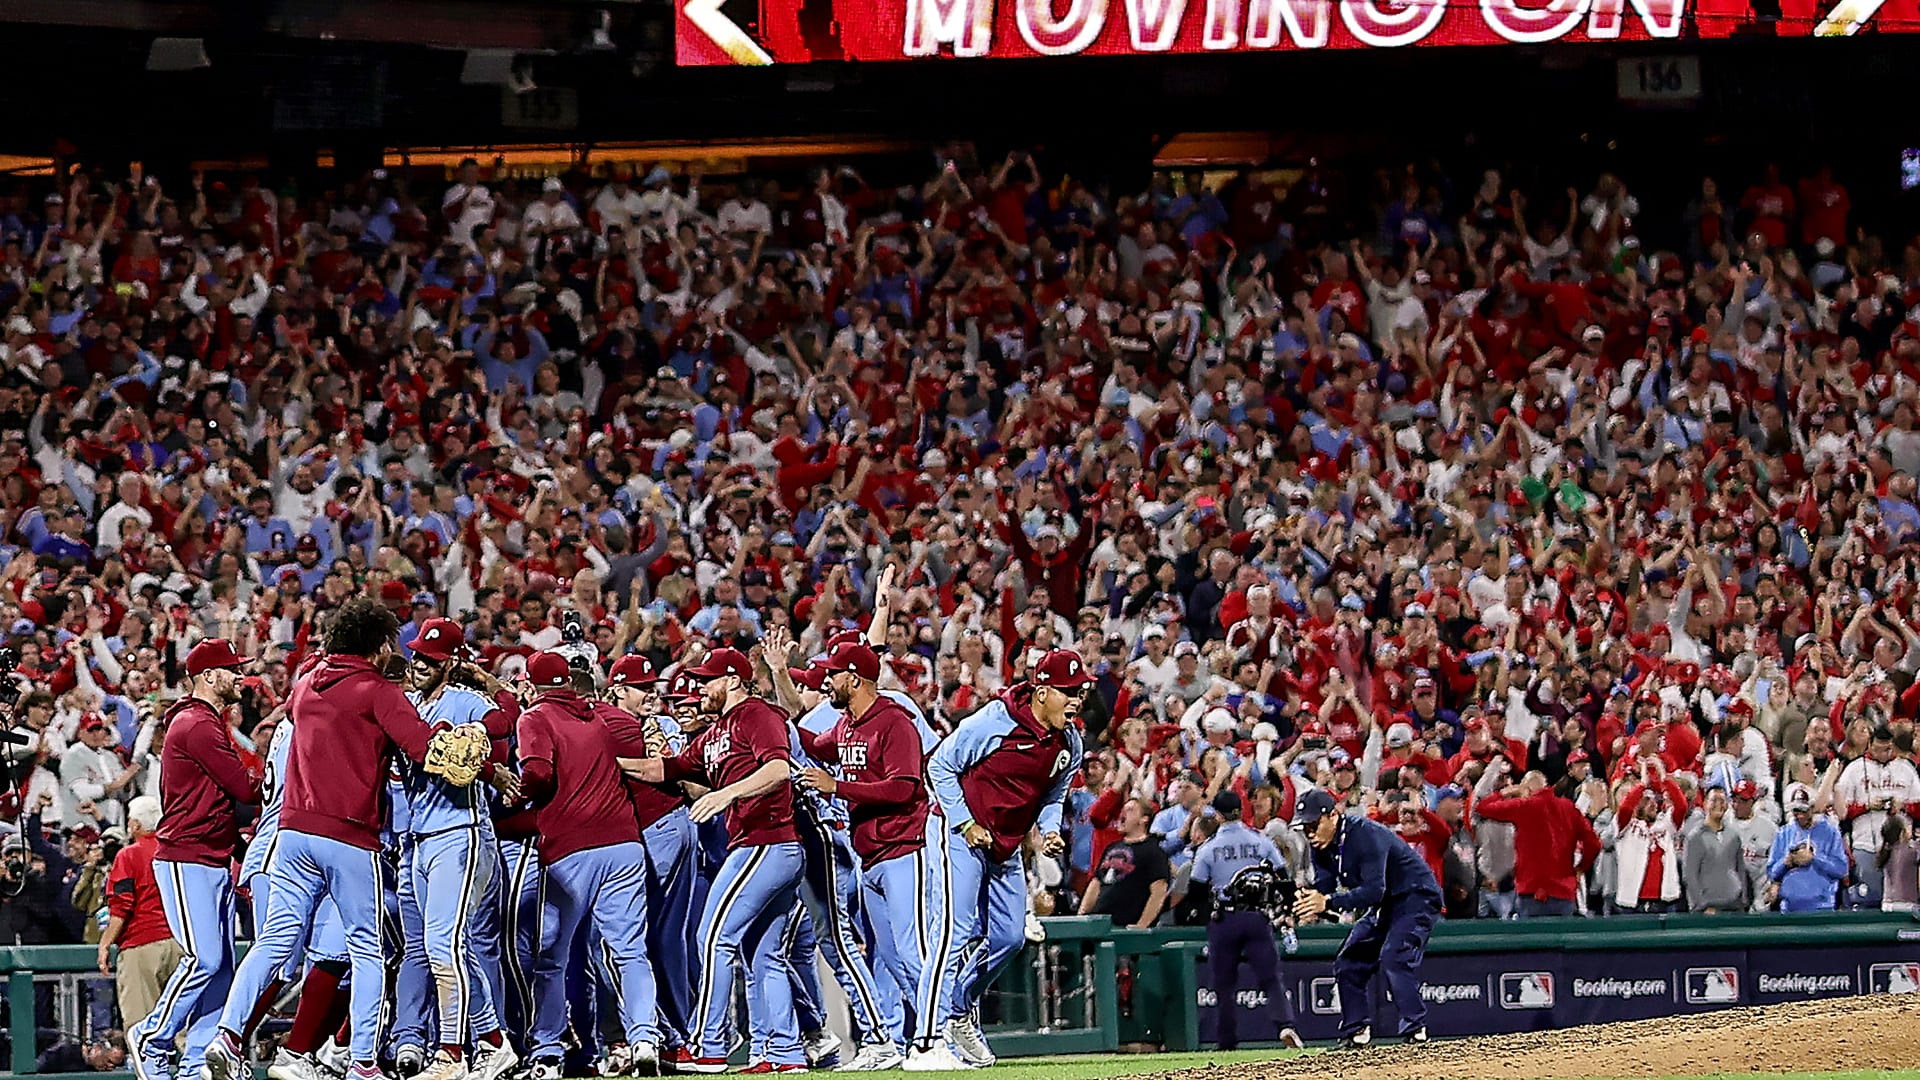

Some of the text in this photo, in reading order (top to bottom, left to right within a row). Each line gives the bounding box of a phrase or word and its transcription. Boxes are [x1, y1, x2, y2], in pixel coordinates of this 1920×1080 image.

[1213, 843, 1261, 863] POLICE
[1573, 977, 1666, 999] Booking.com
[1759, 973, 1851, 995] Booking.com
